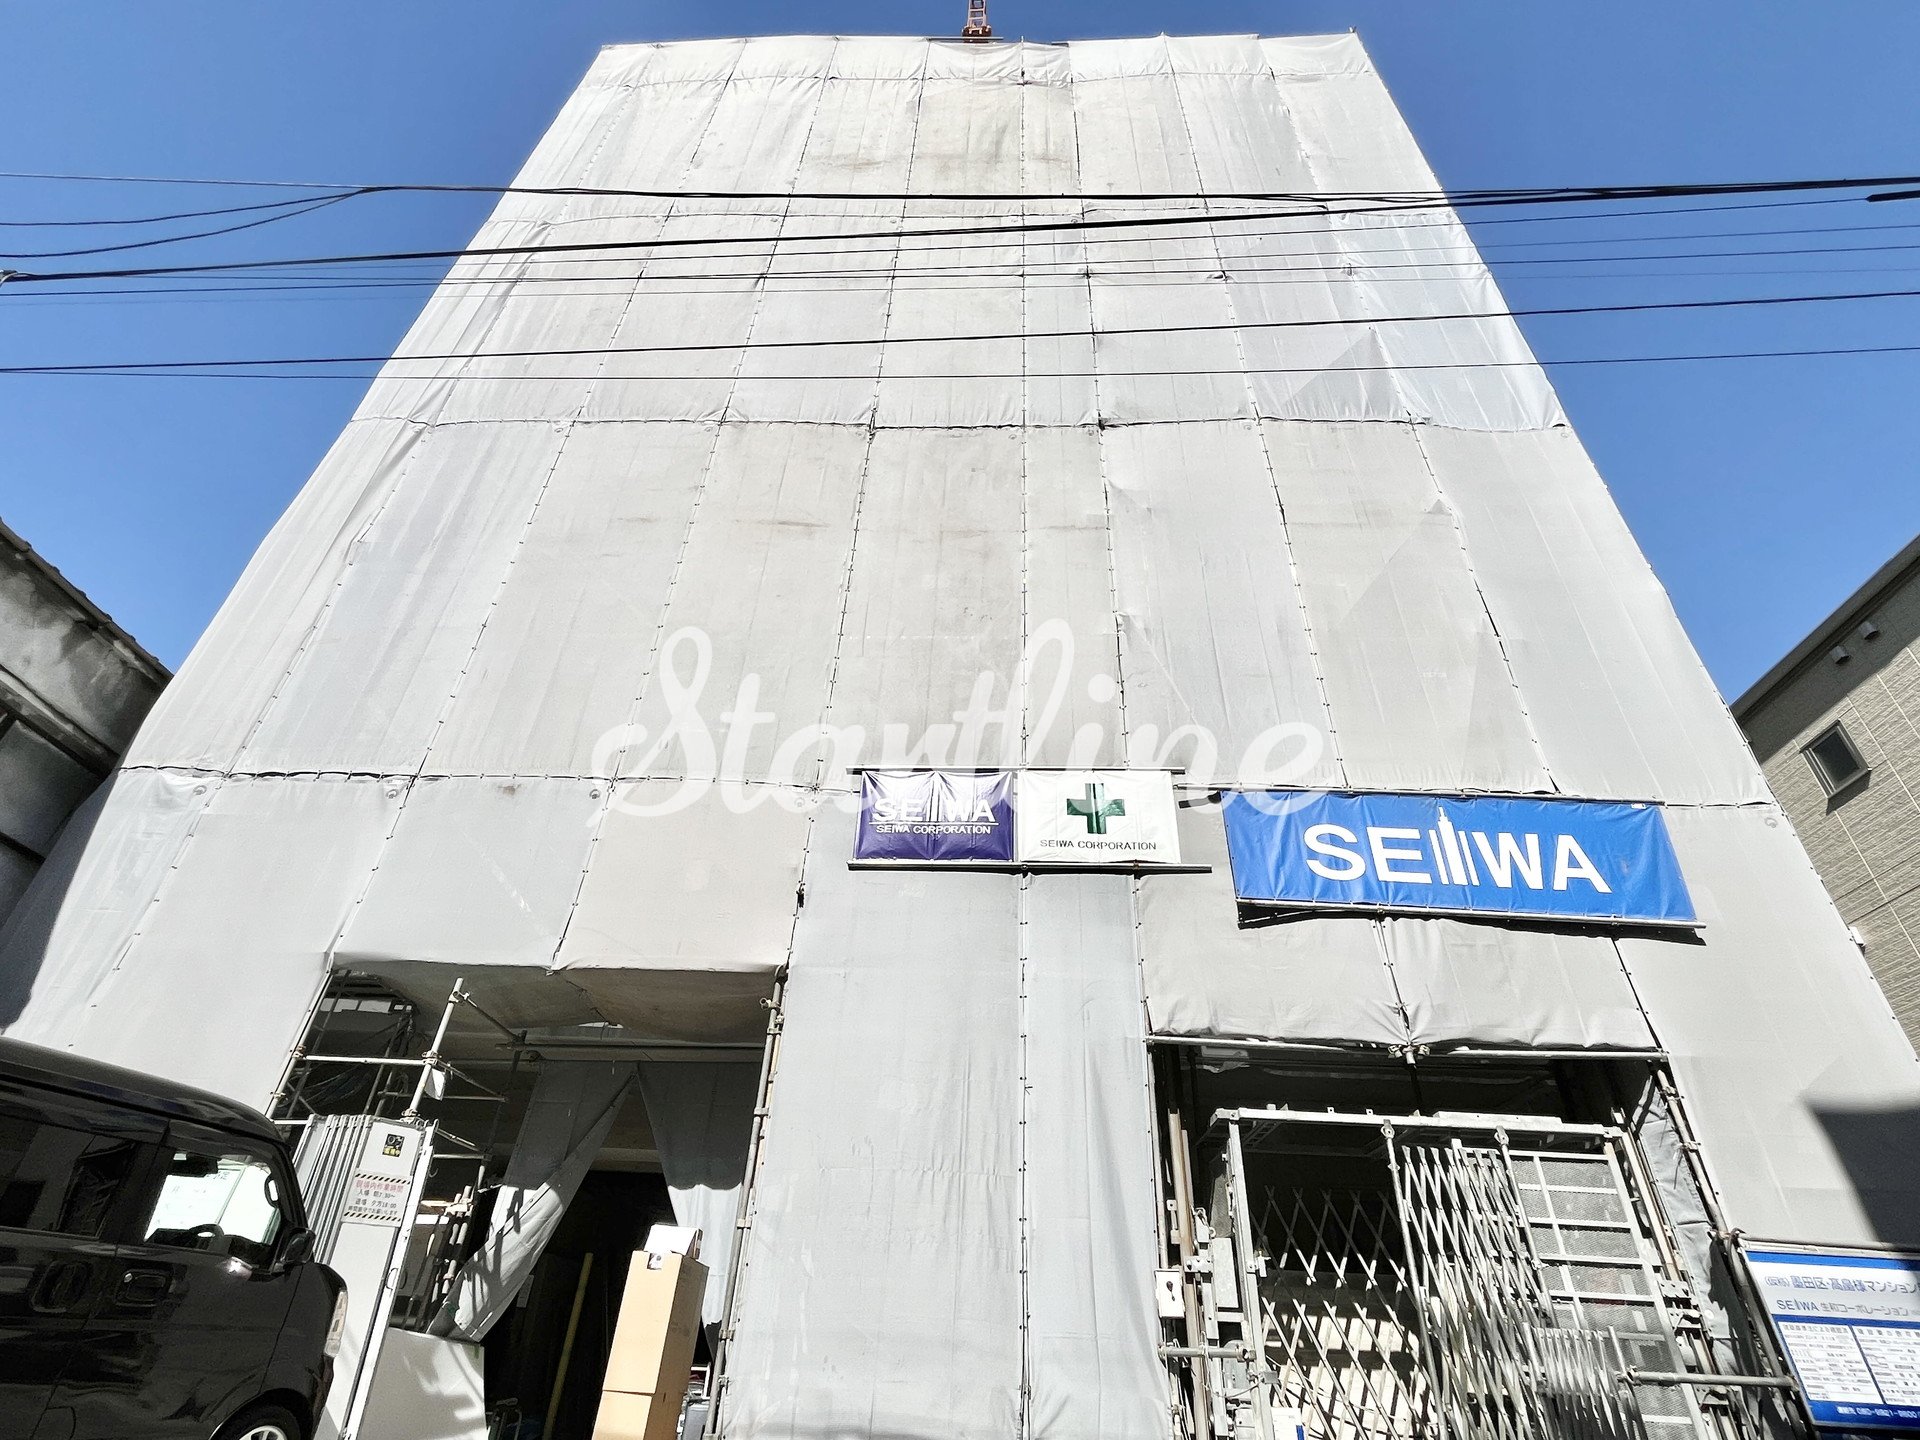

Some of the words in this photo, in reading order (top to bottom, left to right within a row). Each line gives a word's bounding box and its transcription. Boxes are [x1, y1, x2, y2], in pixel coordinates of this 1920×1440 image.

[872, 794, 996, 822] SEIWA
[876, 824, 911, 834] SEIWA
[913, 825, 991, 835] CORPORATION
[1039, 839, 1075, 848] SEIWA
[1077, 840, 1157, 851] CORPORATION
[1303, 806, 1613, 894] SEIWA
[1776, 1299, 1820, 1313] SEIWA
